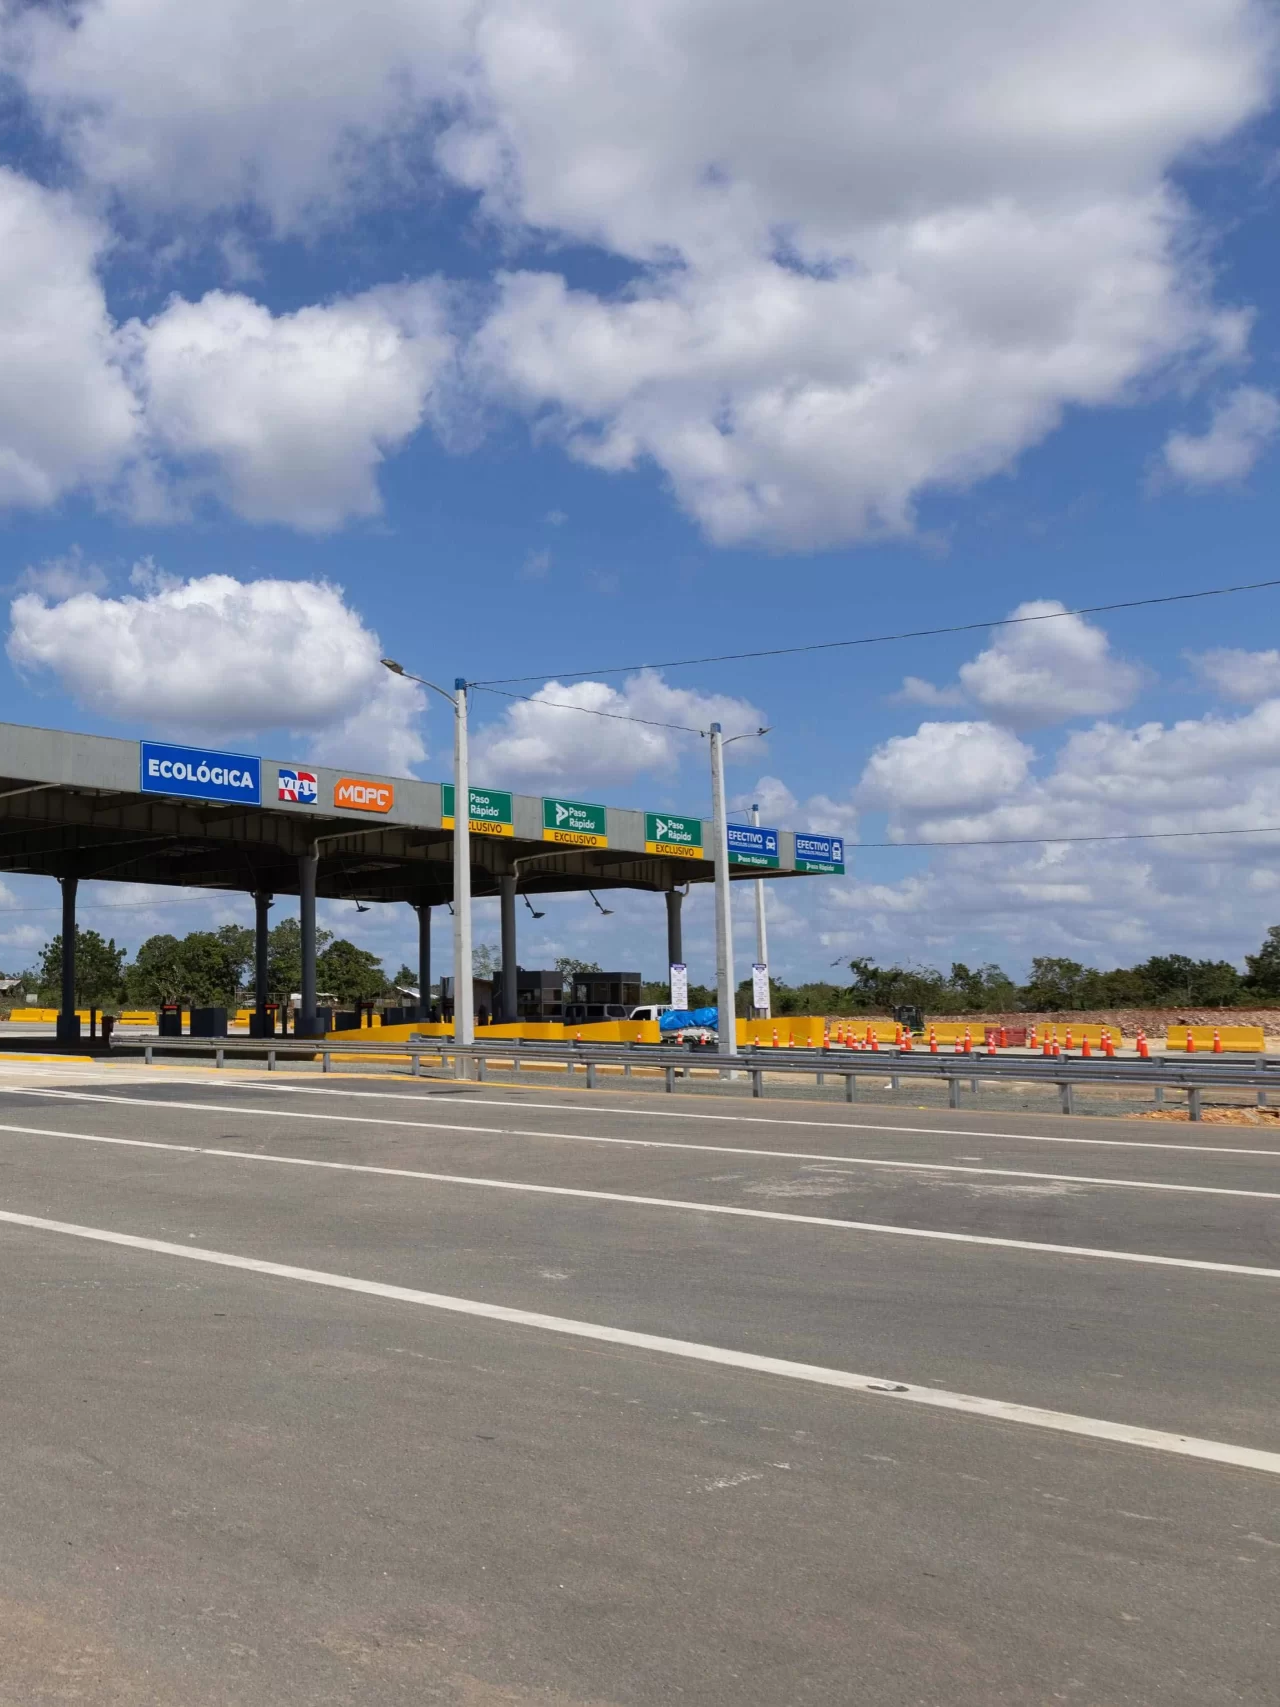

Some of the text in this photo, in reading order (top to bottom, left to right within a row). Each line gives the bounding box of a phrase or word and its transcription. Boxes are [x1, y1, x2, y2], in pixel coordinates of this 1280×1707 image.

[148, 759, 254, 788] ECOLÓGICA
[283, 779, 313, 792] VIAL
[338, 785, 389, 806] MOPC
[470, 793, 490, 804] Paso
[470, 804, 499, 817] Rápido
[569, 807, 587, 818] Paso
[569, 818, 595, 830] Rápido
[667, 819, 684, 830] Paso
[554, 832, 597, 845] EXCLUSIVO
[728, 830, 763, 843] EFECTIVO
[655, 844, 695, 856] EXCLUSIVO
[797, 839, 829, 852] EFECTIVO
